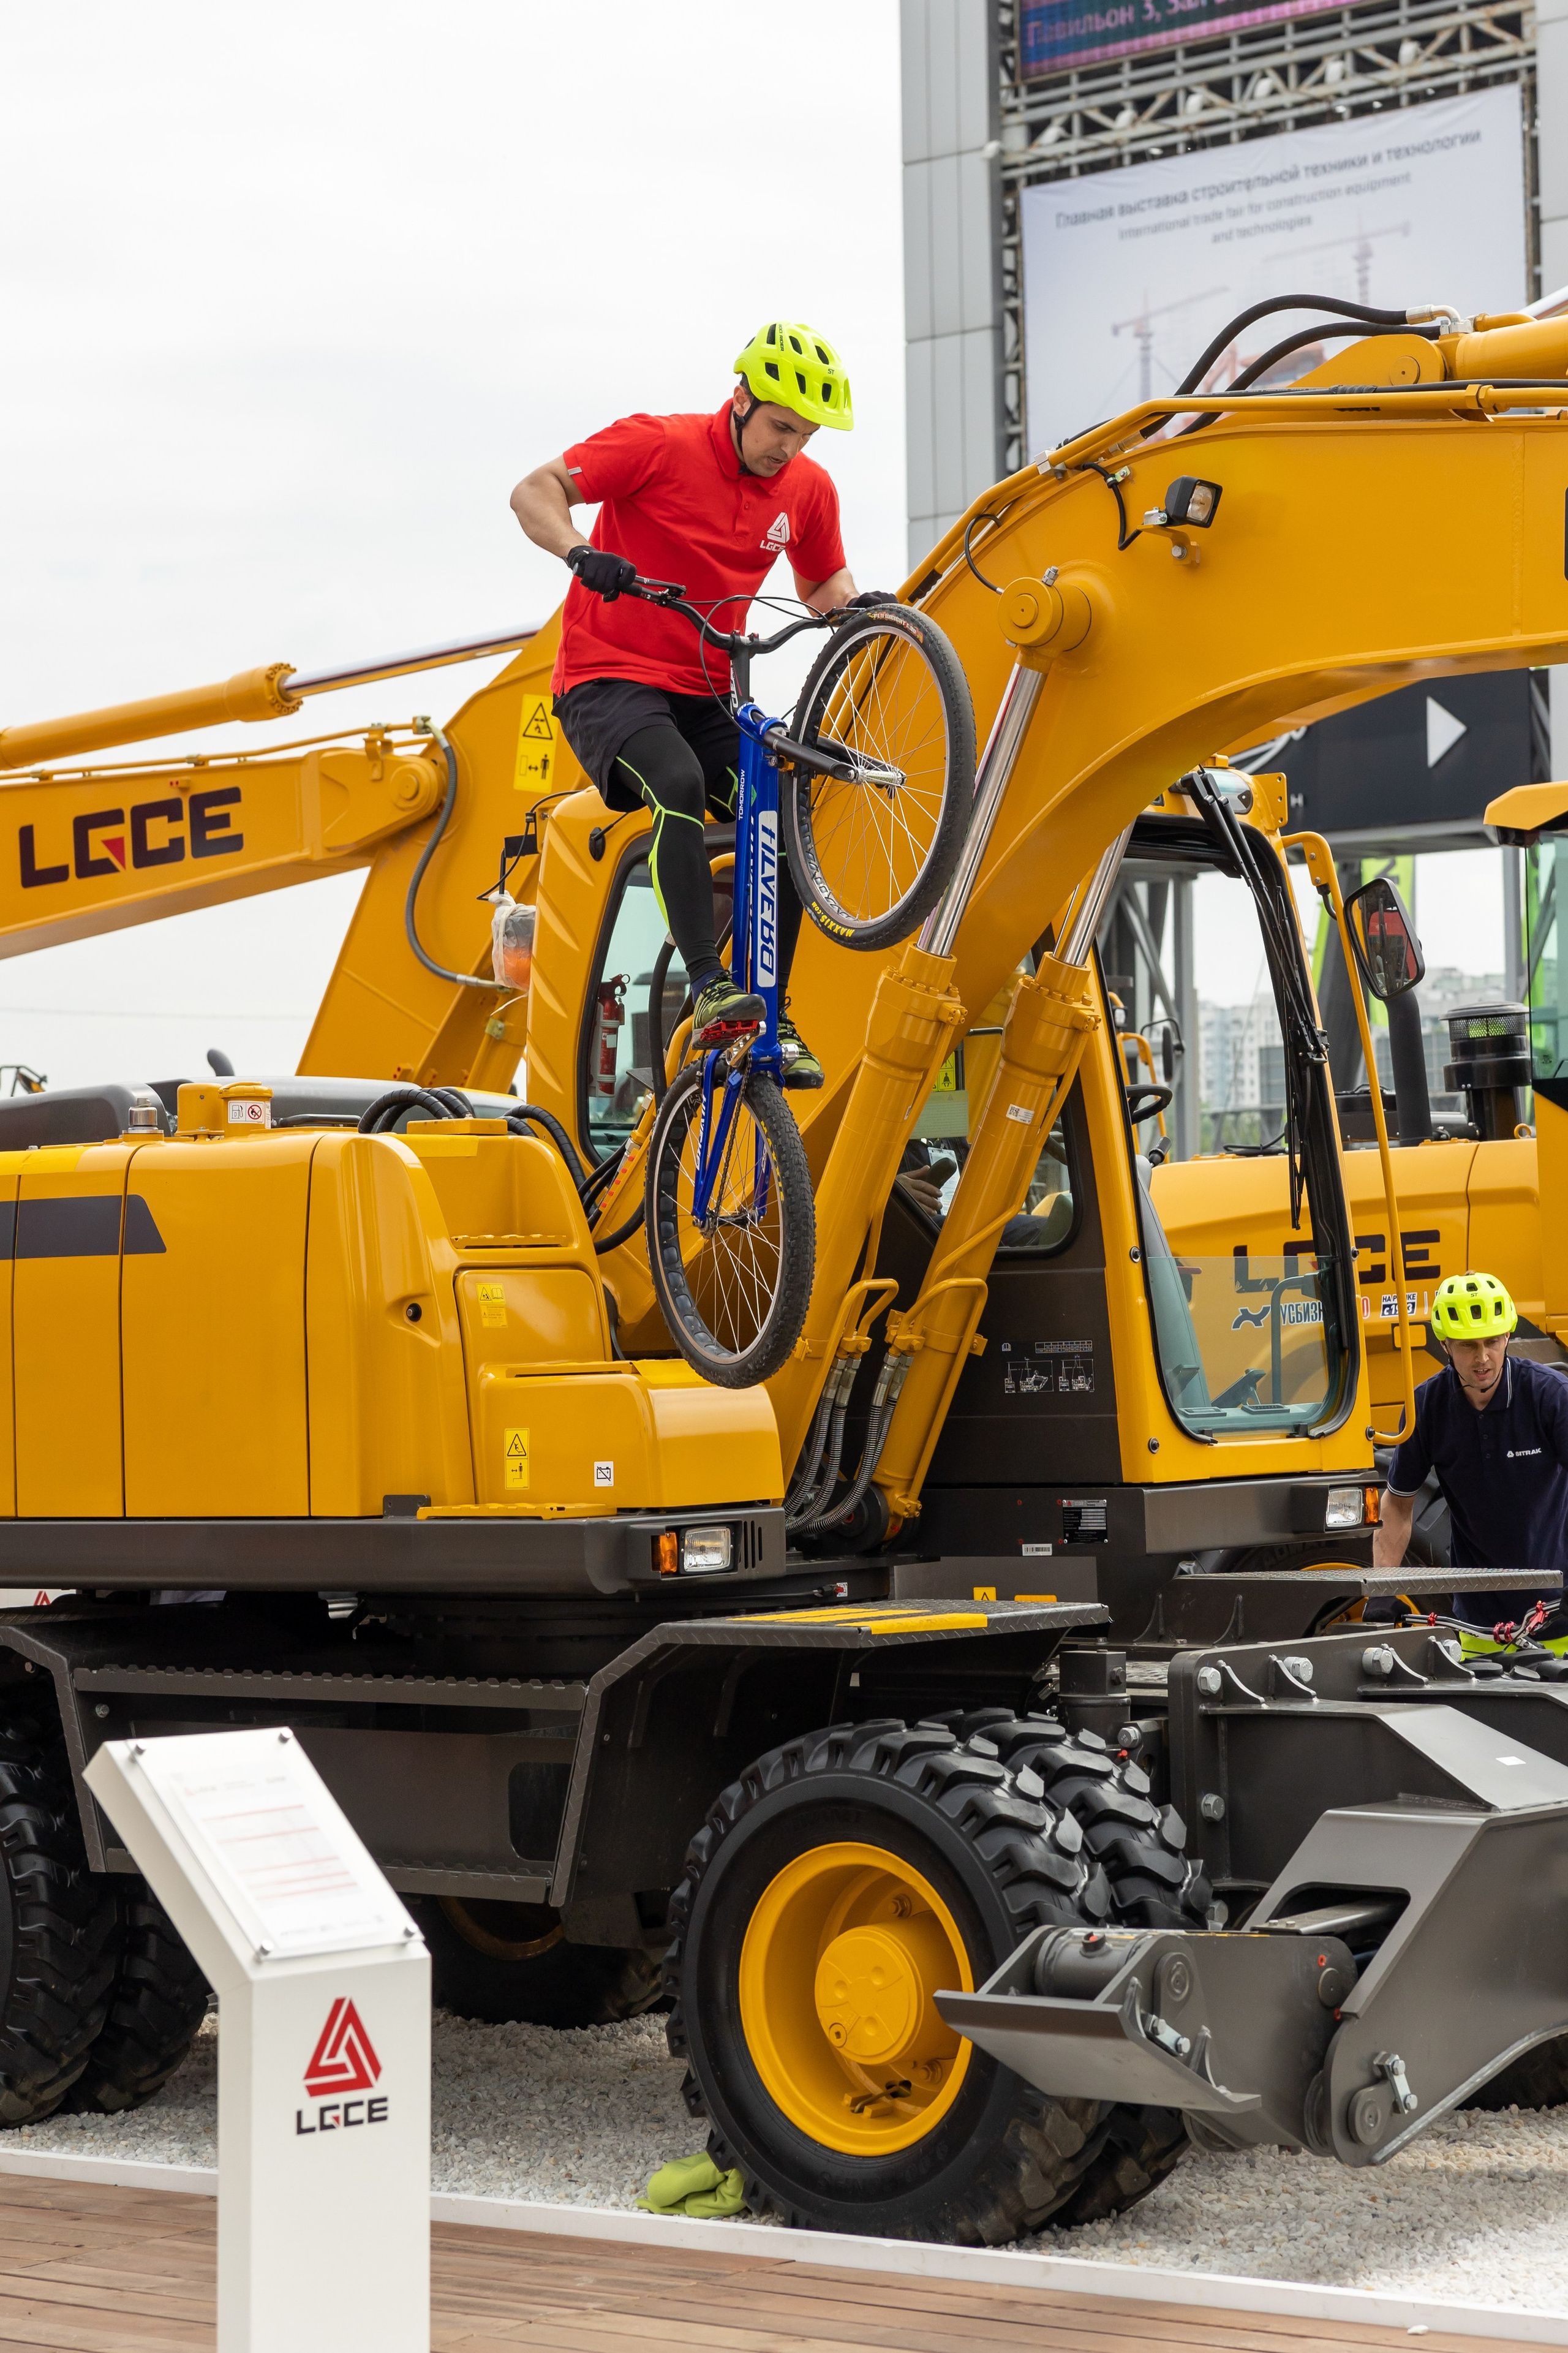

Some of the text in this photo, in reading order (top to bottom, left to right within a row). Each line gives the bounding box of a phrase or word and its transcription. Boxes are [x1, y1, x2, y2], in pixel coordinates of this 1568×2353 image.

[1055, 205, 1115, 229] Главная
[1118, 191, 1189, 214] выставка
[1191, 164, 1300, 202] строительной
[1303, 154, 1368, 176] техники
[1385, 130, 1482, 161] технологии
[1118, 216, 1190, 240] International
[1266, 185, 1343, 211] construction
[1344, 172, 1412, 196] equipment
[1236, 215, 1312, 240] technologies
[760, 540, 786, 551] LGCE
[19, 787, 244, 888] LGCE
[1515, 1448, 1542, 1456] SITRAK
[296, 2096, 389, 2135] LGCE
